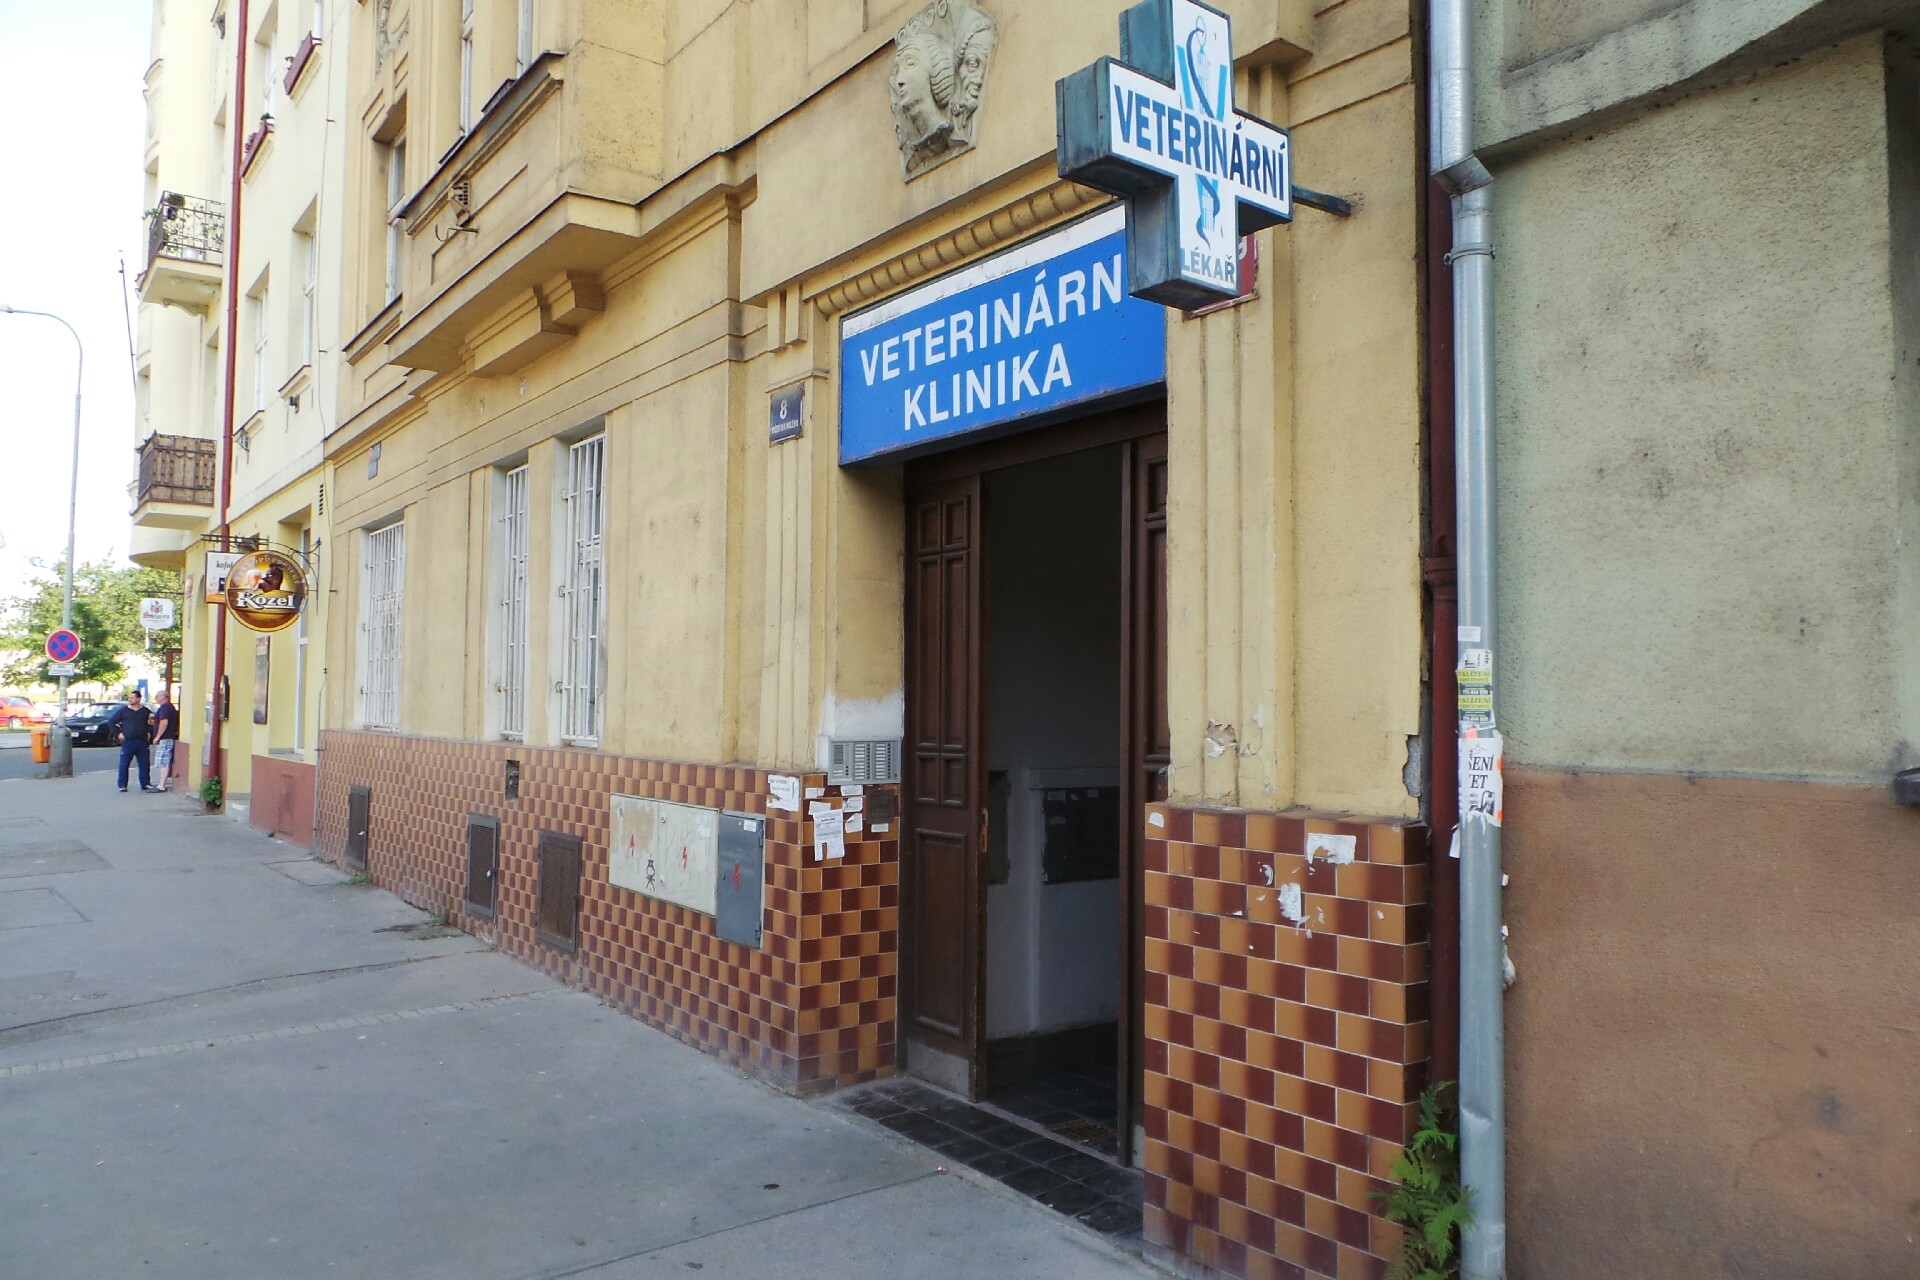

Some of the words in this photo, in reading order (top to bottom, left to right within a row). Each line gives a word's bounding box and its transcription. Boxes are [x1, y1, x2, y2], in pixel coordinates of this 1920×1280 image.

[1114, 84, 1288, 201] VETERINÁRNÍ
[1181, 247, 1236, 284] LÉKAŘ
[860, 253, 1123, 387] VETERINÁRN
[904, 343, 1072, 431] KLINIKA
[779, 399, 788, 420] 8
[216, 560, 234, 570] kofol
[236, 591, 295, 610] Kozel
[1468, 774, 1489, 789] ET
